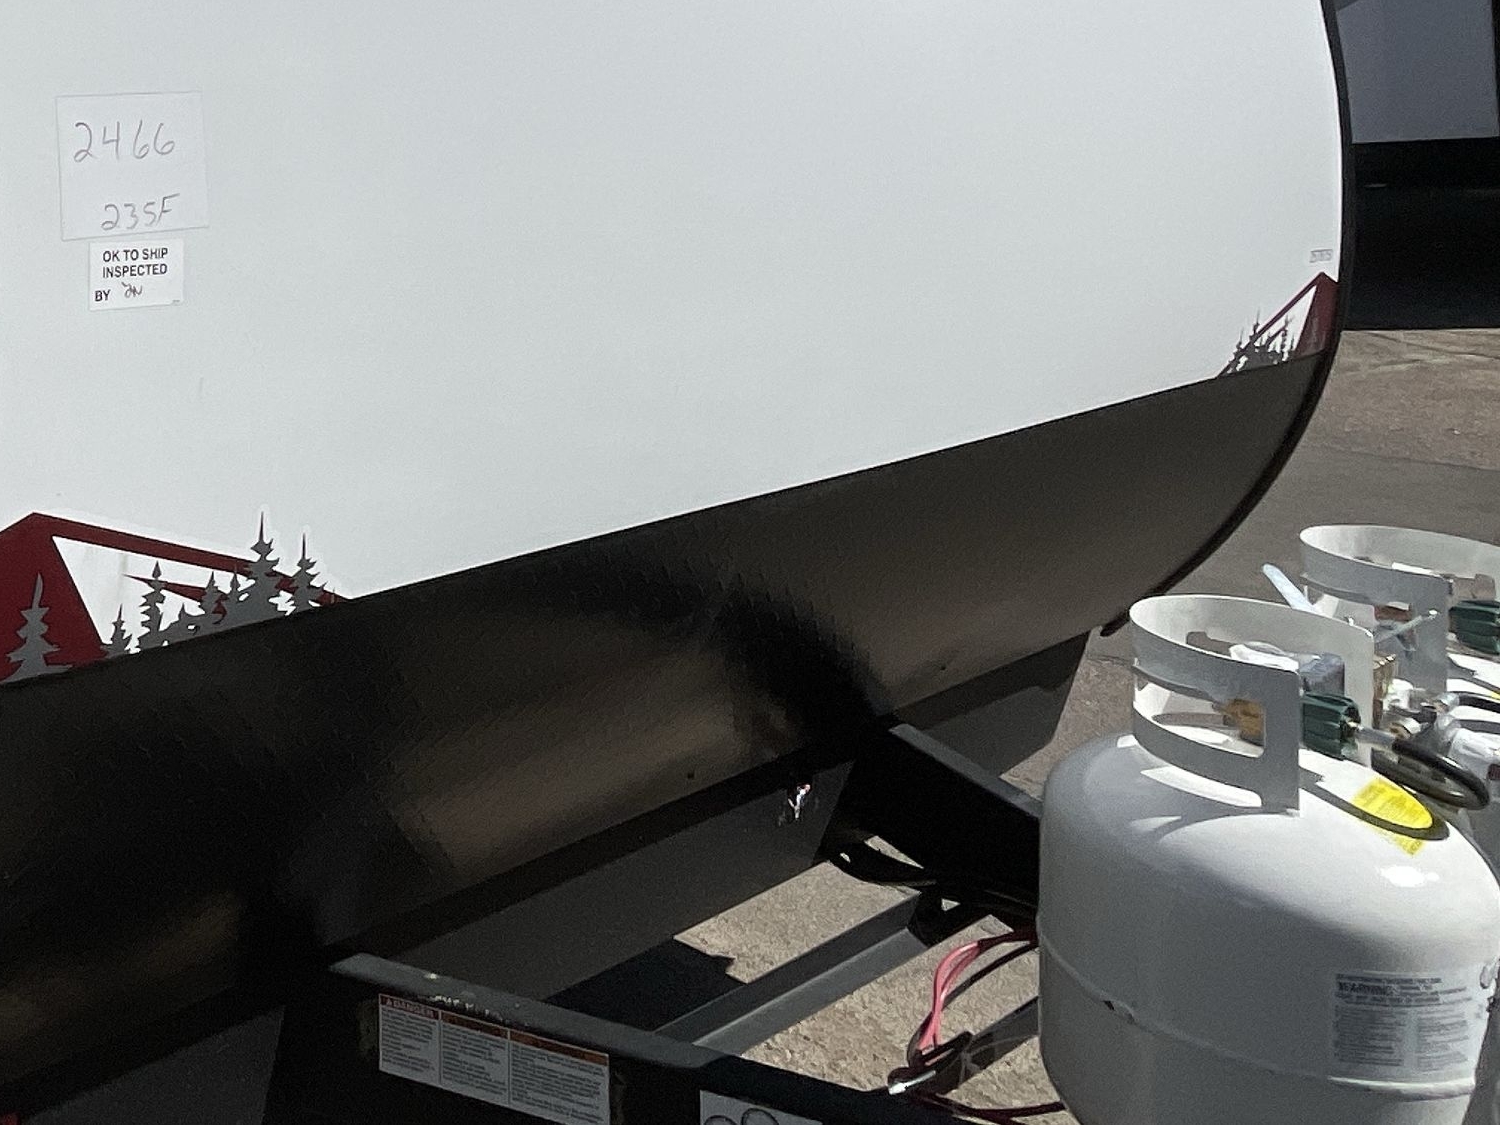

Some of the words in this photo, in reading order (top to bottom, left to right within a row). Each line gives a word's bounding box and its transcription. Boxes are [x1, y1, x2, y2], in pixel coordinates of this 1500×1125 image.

[73, 119, 176, 163] 2466
[102, 250, 120, 263] OK
[123, 248, 139, 261] TO
[142, 247, 168, 261] SHIP
[102, 263, 168, 279] INSPECTED
[94, 289, 111, 302] BY
